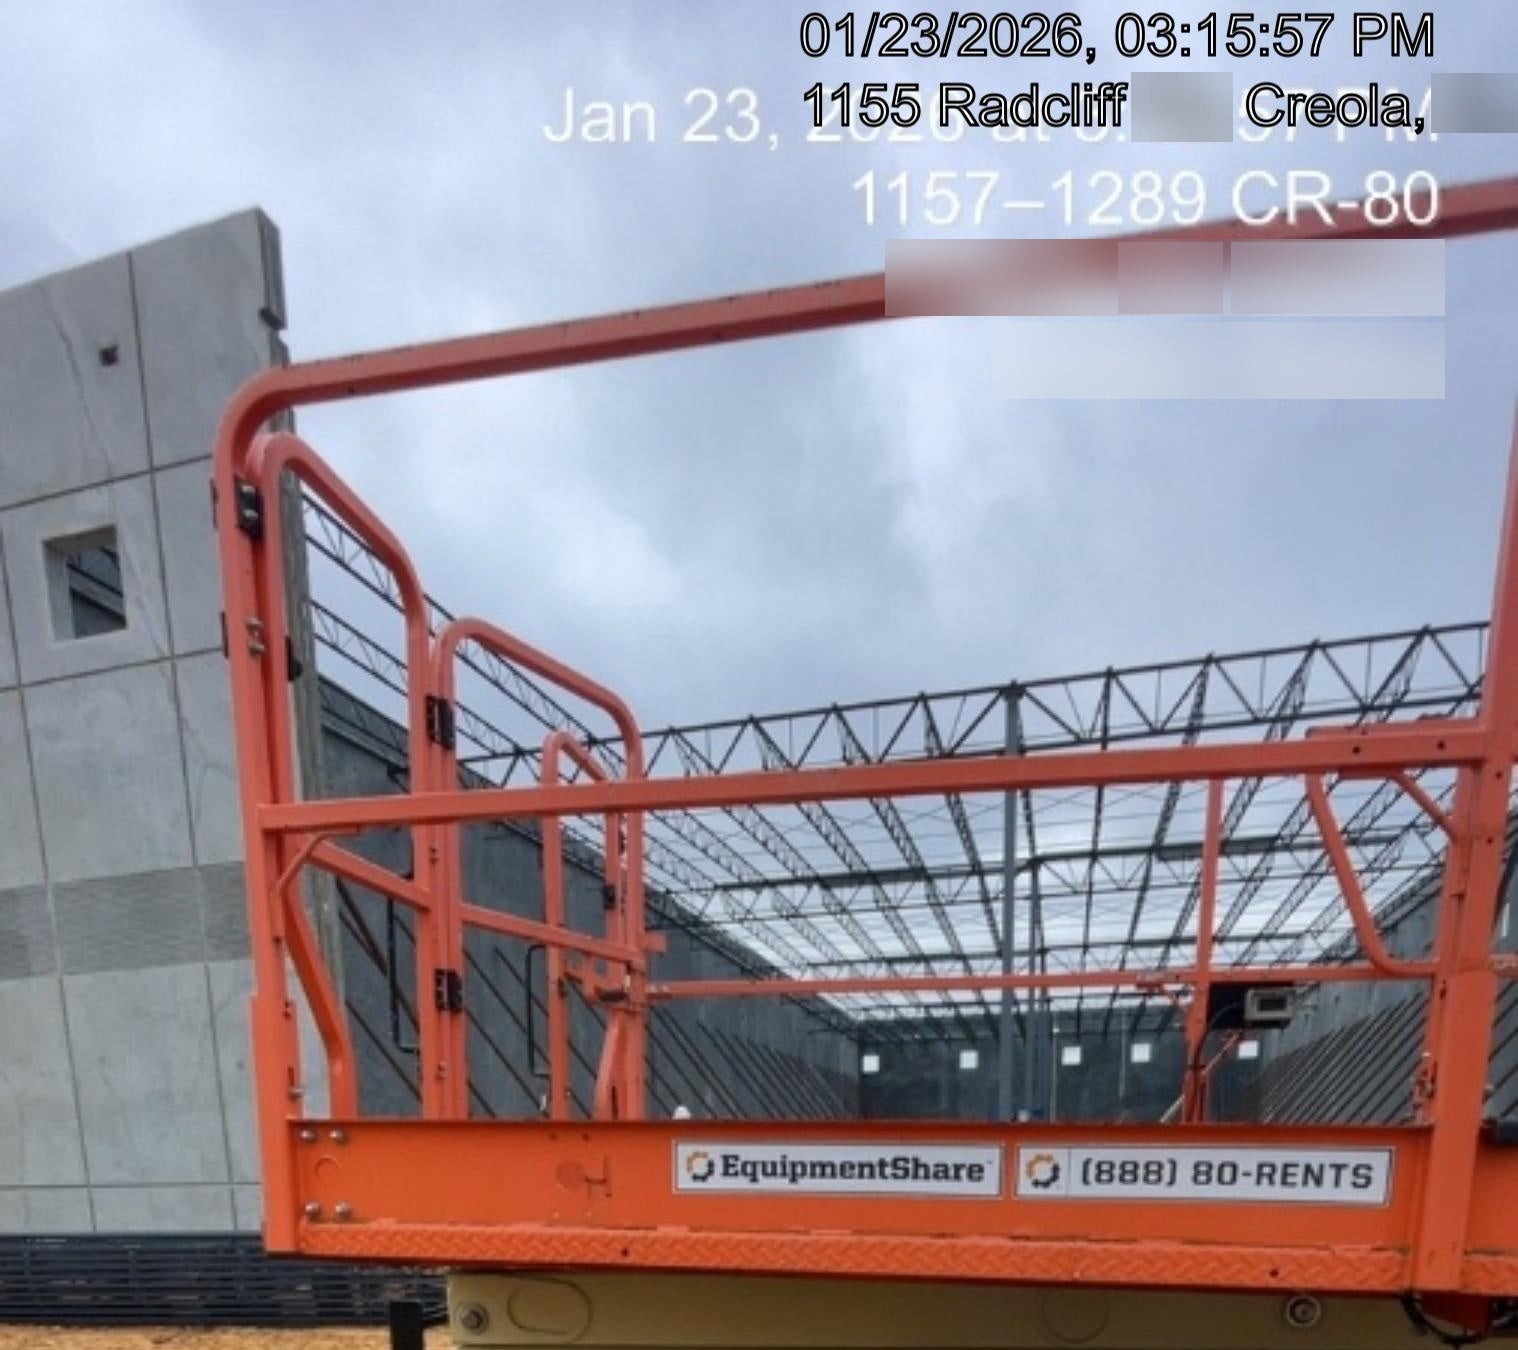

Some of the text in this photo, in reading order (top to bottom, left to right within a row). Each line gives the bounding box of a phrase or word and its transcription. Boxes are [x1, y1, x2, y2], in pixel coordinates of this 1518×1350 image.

[719, 1154, 985, 1184] EquipmentShare
[1080, 1157, 1375, 1189] (888) 80-RENTS
